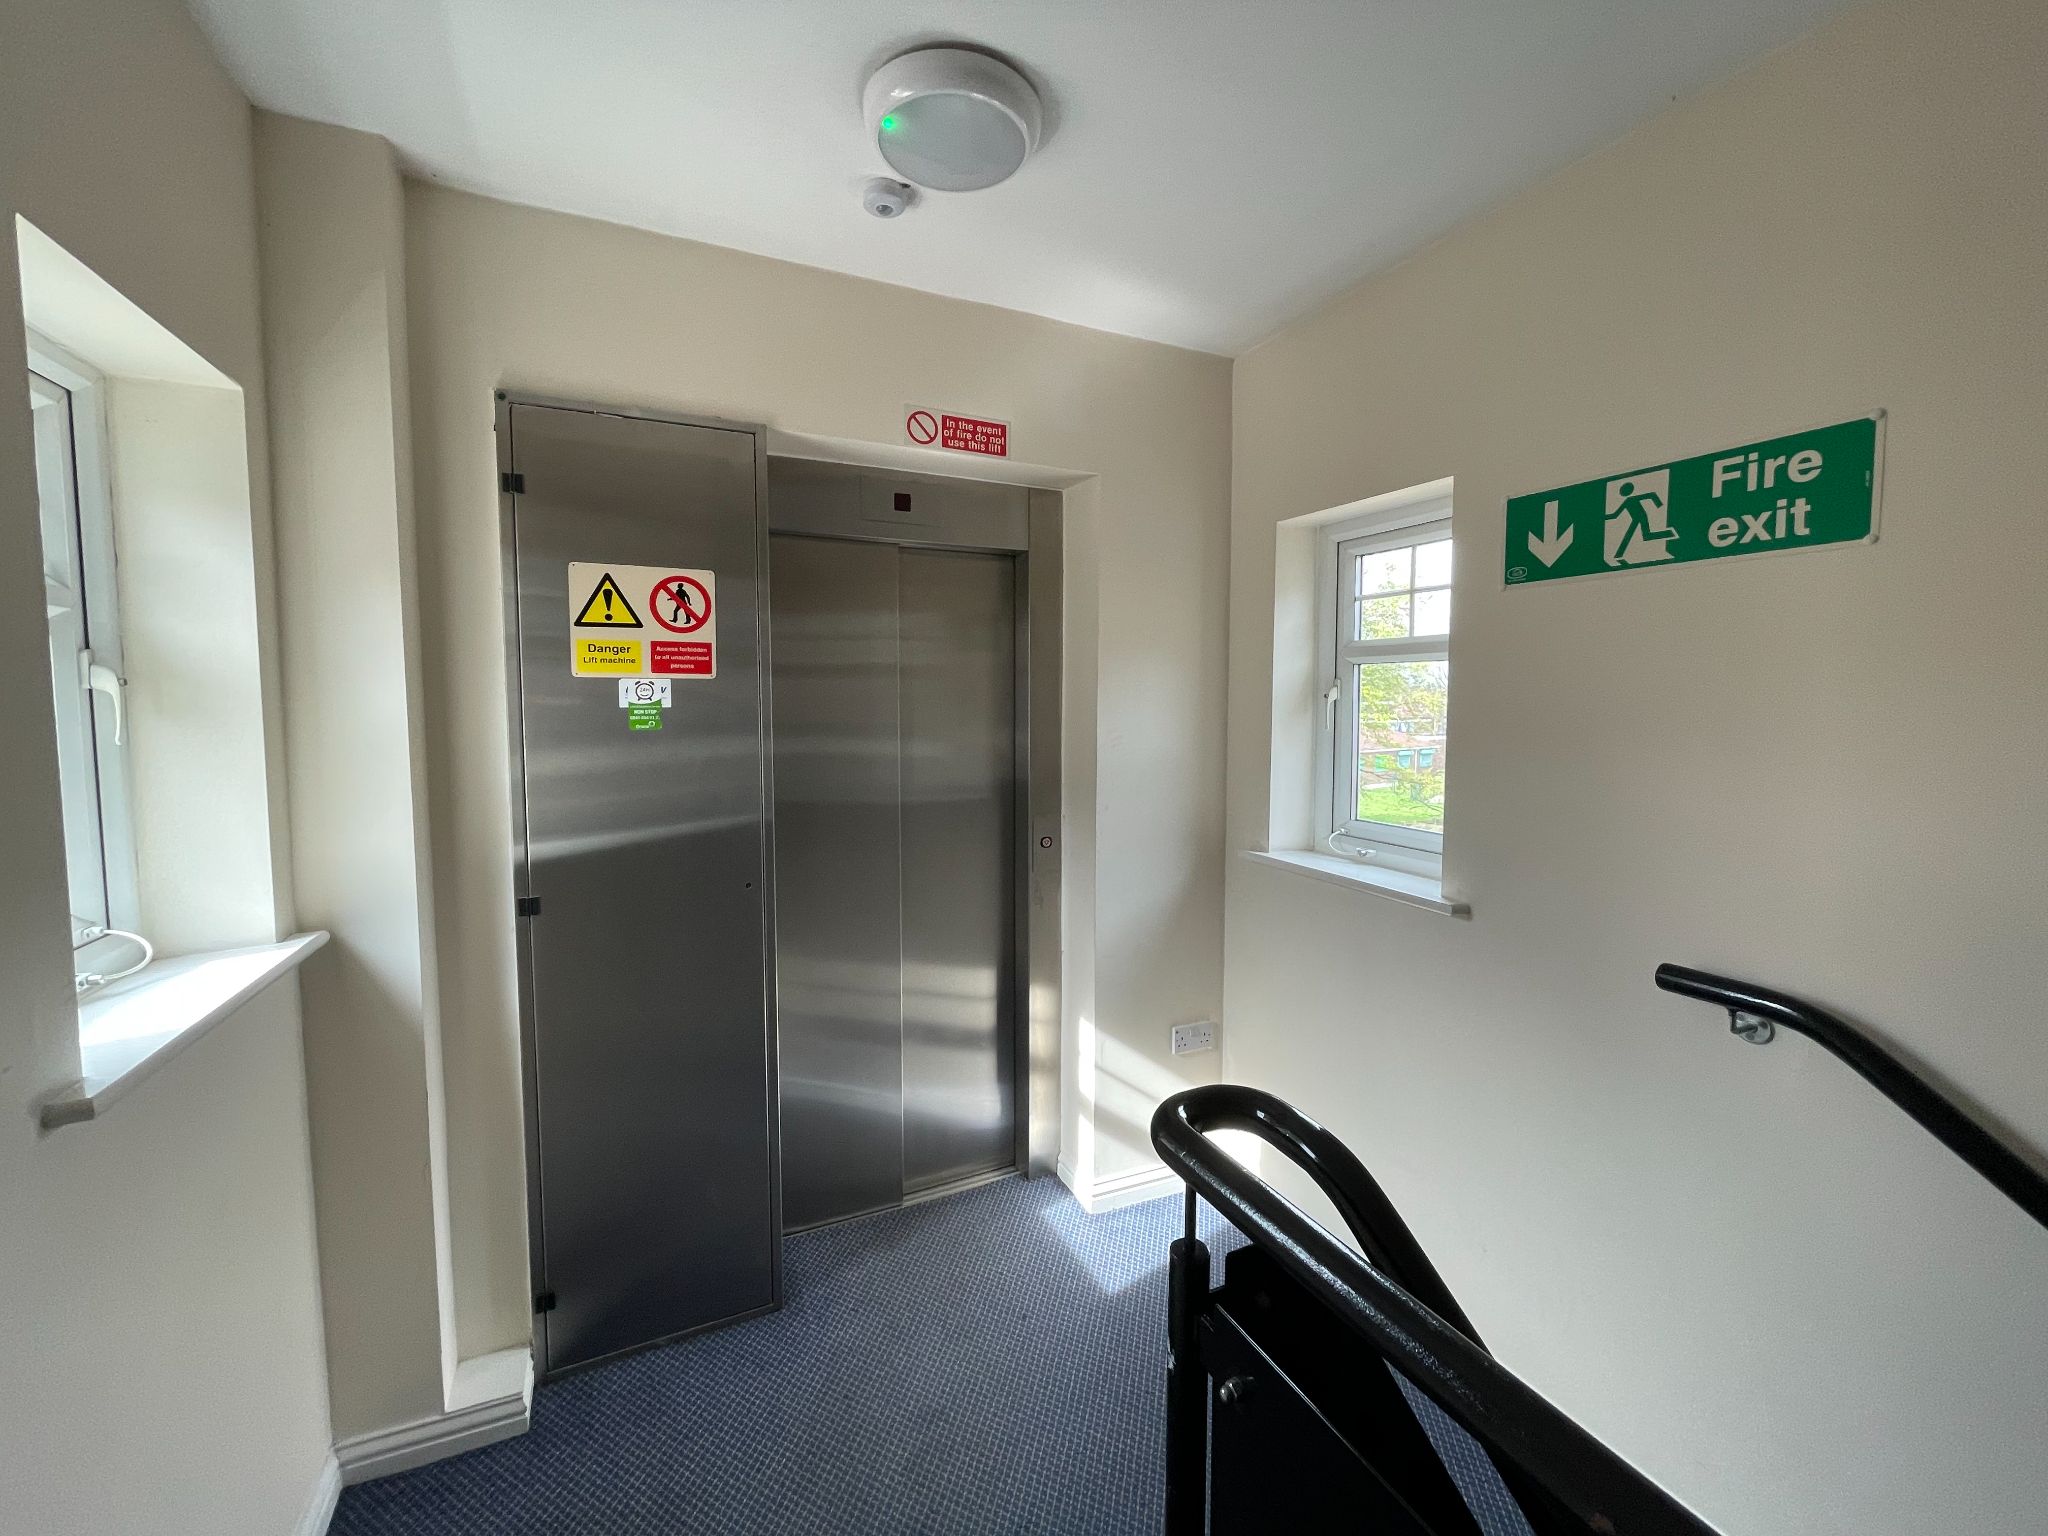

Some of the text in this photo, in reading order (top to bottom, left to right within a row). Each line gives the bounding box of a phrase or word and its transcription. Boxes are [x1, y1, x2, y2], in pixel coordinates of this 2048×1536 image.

[946, 418, 1002, 436] In the event
[943, 429, 1005, 445] of fire do not
[948, 439, 1001, 453] use this lift
[1712, 448, 1824, 498] Fire
[1707, 497, 1812, 548] exit
[588, 643, 631, 656] Danger
[583, 656, 598, 664] Lift
